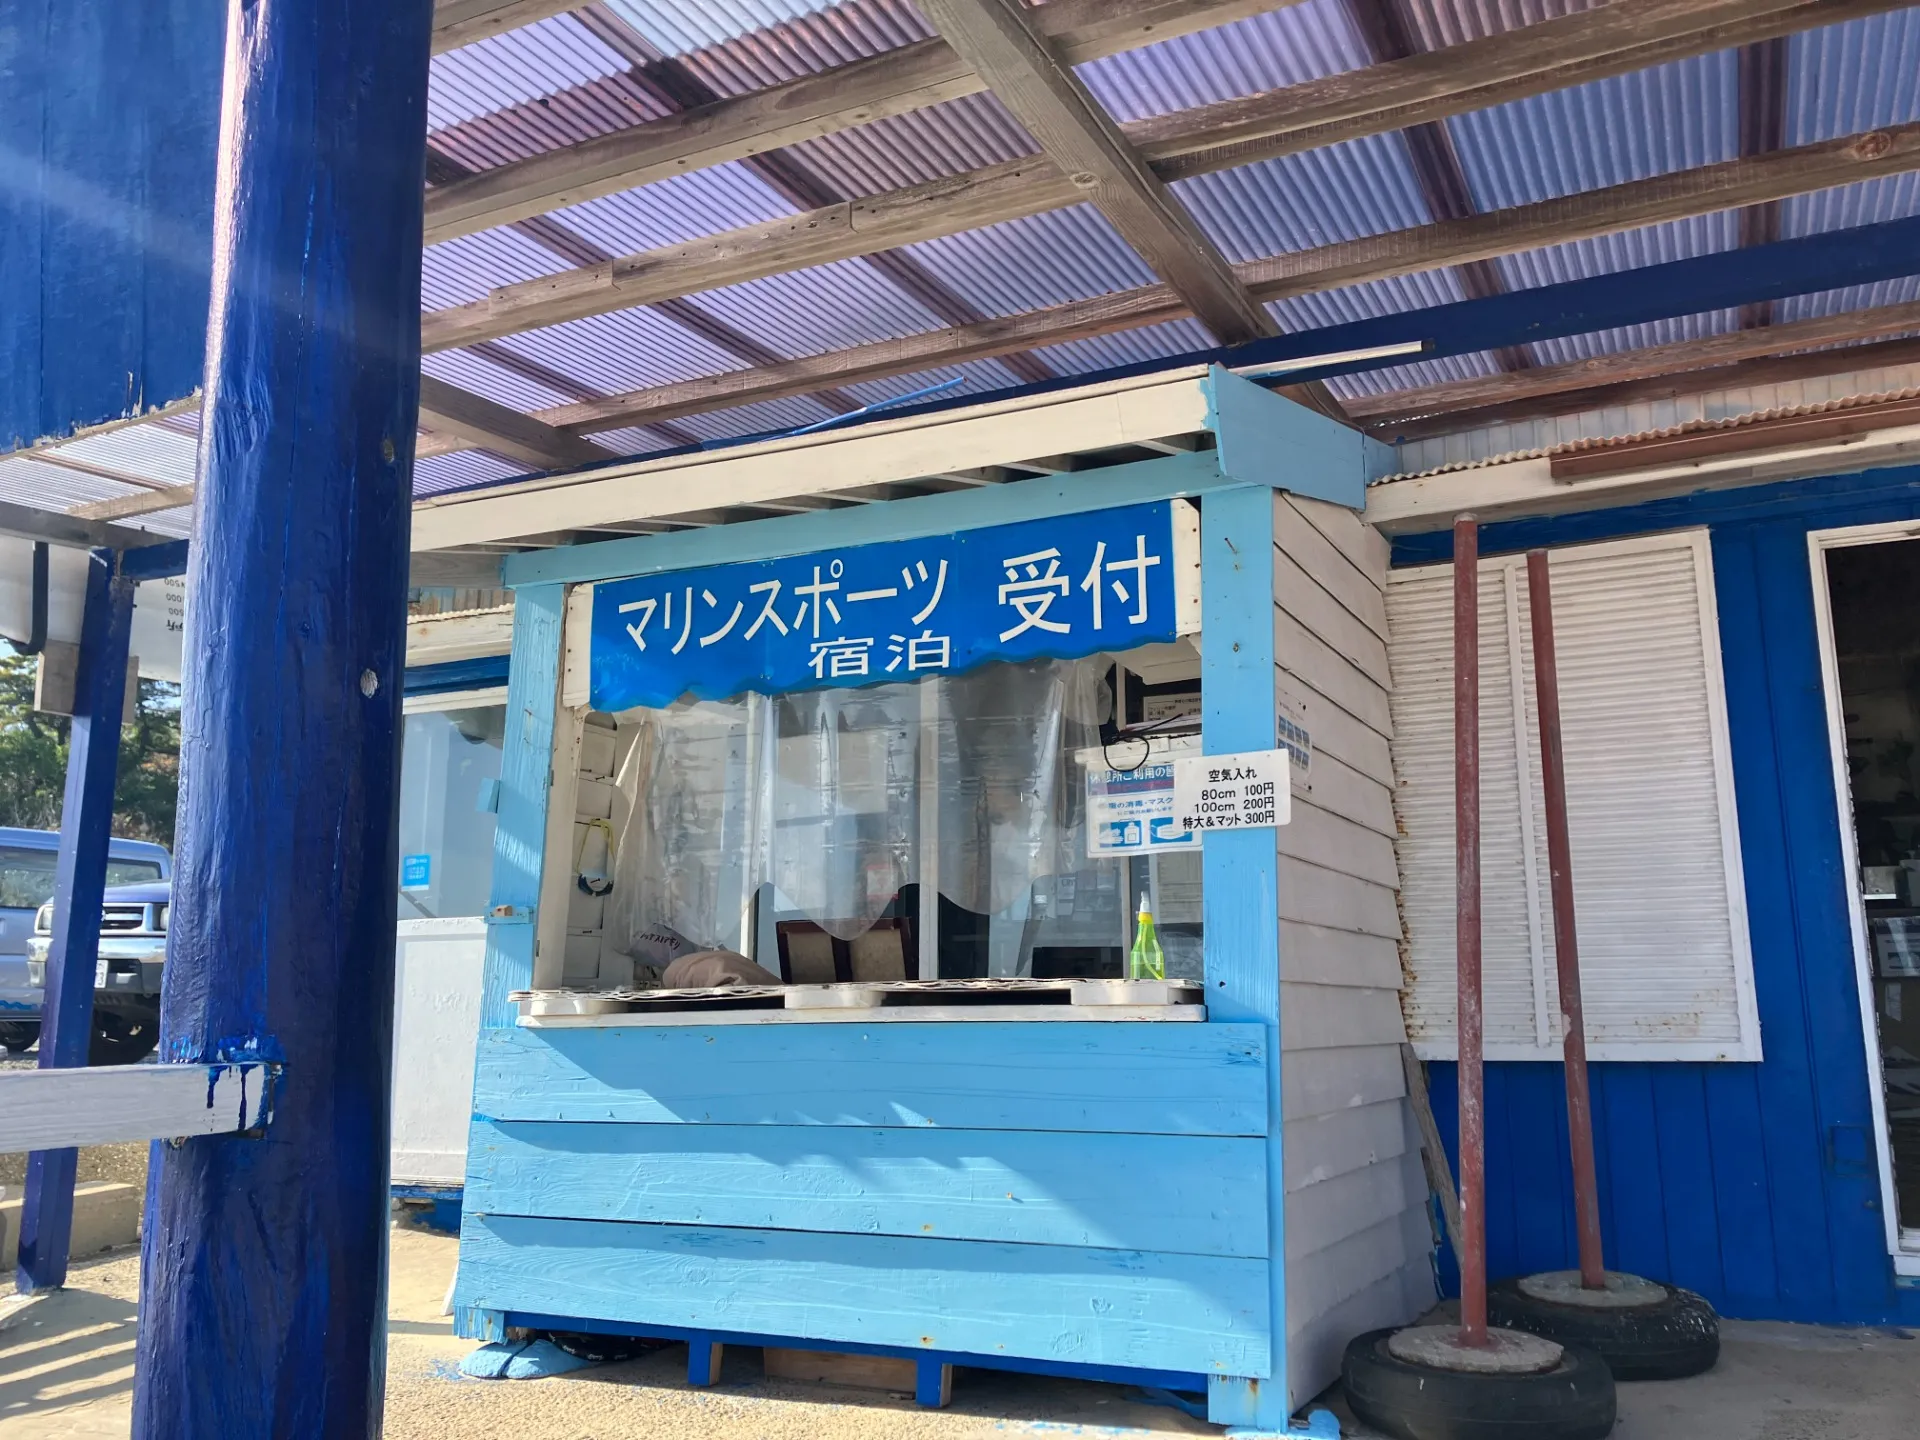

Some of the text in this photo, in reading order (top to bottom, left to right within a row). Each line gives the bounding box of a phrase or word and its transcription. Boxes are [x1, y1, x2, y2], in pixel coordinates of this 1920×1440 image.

[617, 534, 1161, 656] マリンスポーツ 受付
[808, 629, 950, 679] 宿泊
[1208, 766, 1258, 783] 空気入れ
[1201, 781, 1275, 801] 80cm 100円
[1194, 795, 1276, 814] 100cm 200円
[1244, 810, 1276, 825] 300円
